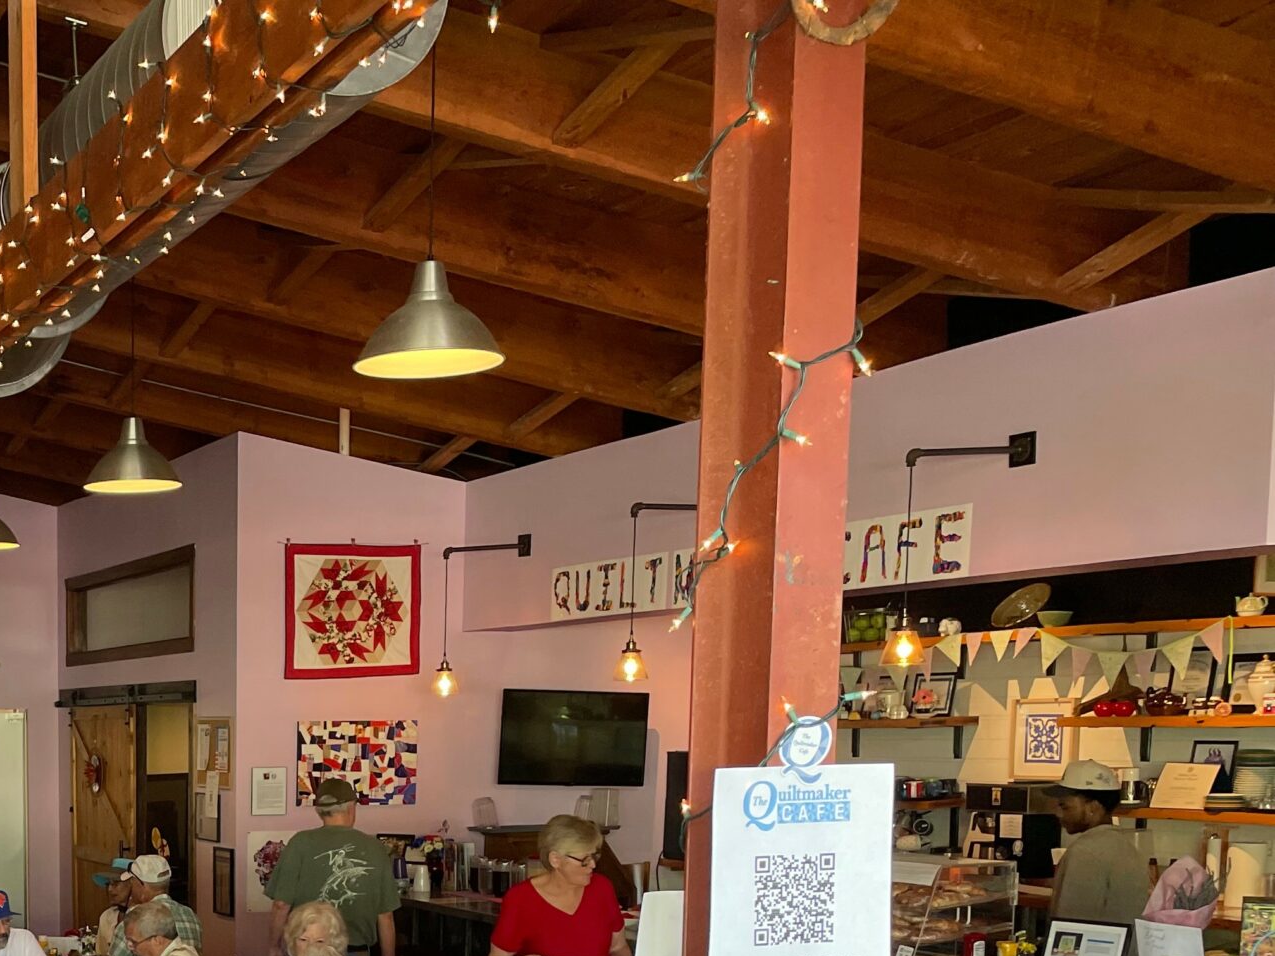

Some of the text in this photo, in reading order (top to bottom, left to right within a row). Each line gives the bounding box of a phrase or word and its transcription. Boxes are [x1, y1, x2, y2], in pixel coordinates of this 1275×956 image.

[844, 511, 965, 586] AFE
[743, 781, 851, 831] The Quiltmaker
